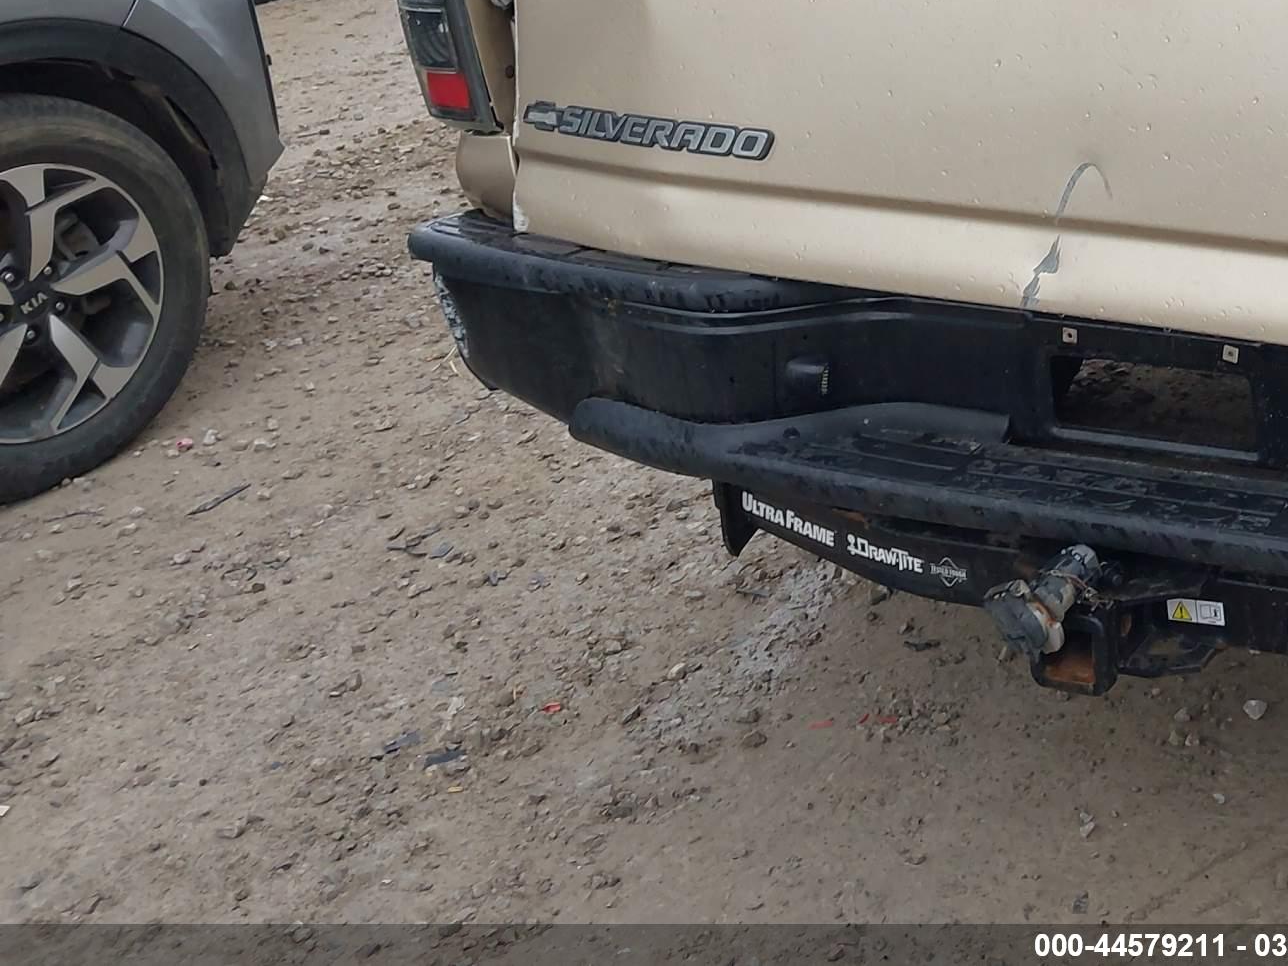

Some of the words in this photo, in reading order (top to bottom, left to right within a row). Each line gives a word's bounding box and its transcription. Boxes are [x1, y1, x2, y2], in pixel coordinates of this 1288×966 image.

[560, 105, 774, 161] SILVERADO
[20, 292, 48, 315] KIA
[741, 491, 785, 527] ULTRA
[785, 509, 836, 547] FRAME
